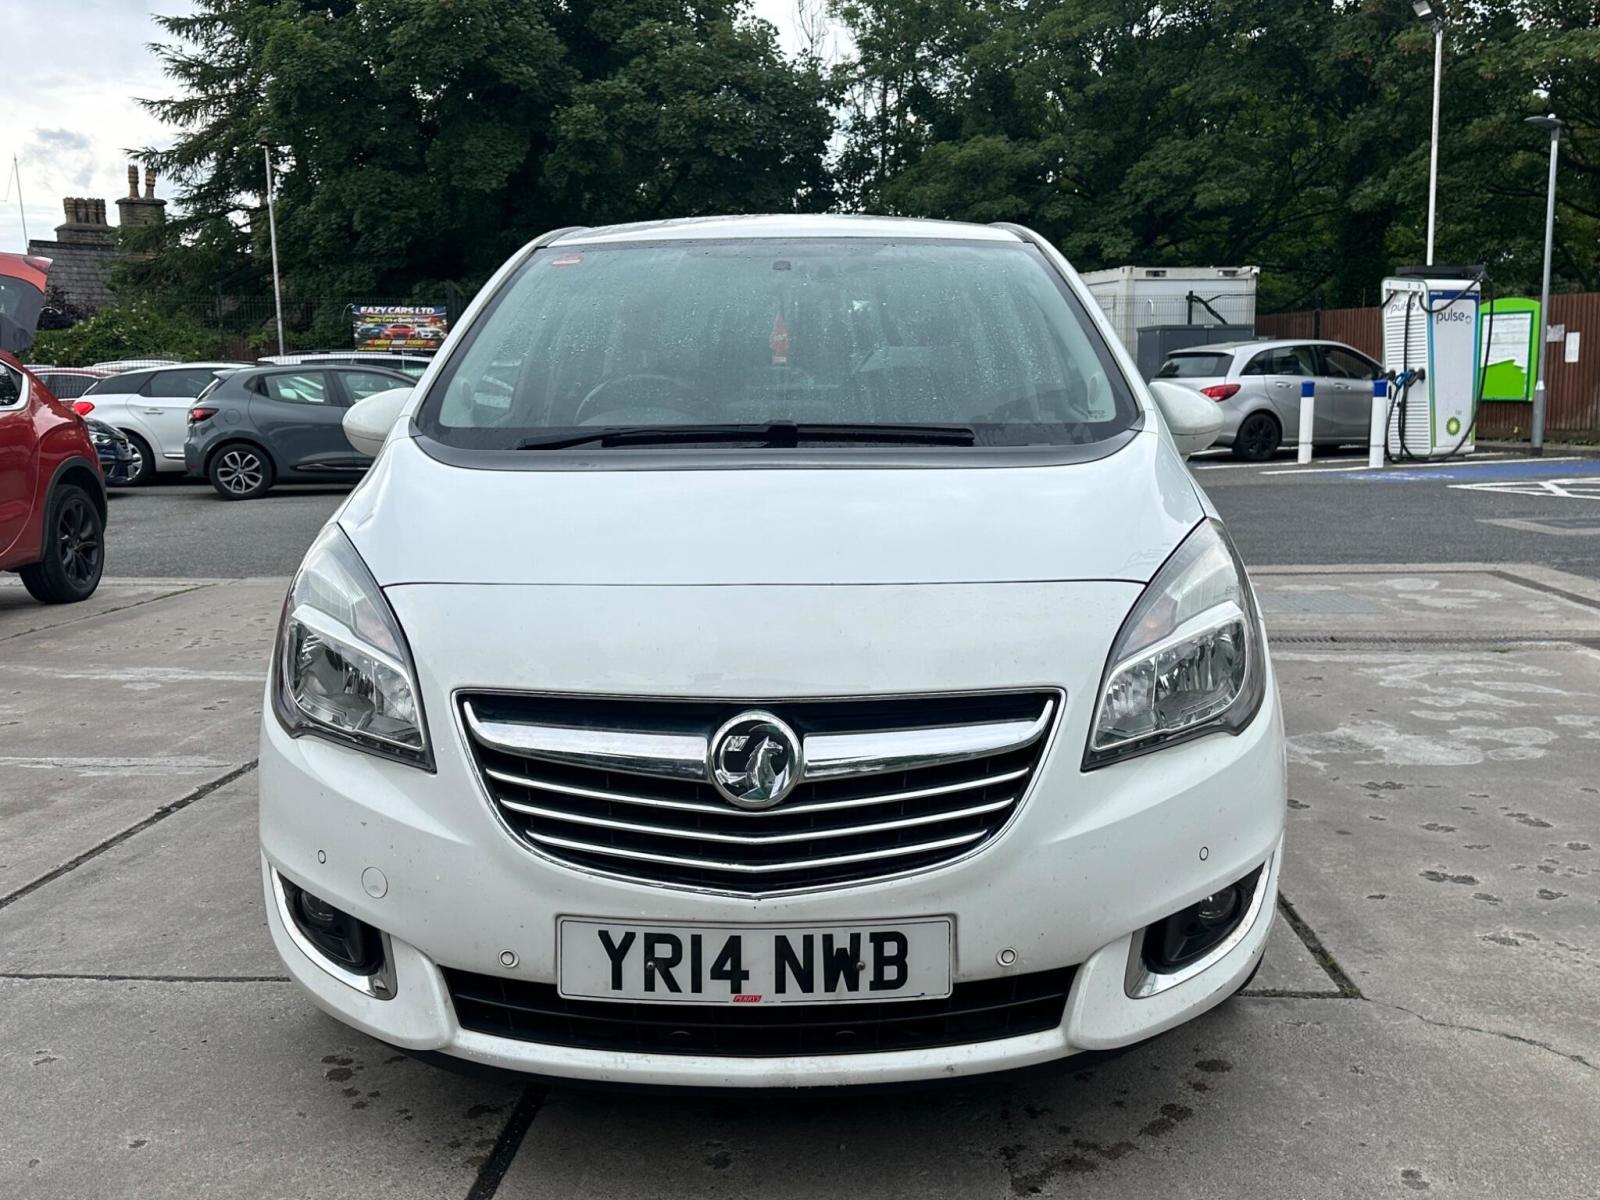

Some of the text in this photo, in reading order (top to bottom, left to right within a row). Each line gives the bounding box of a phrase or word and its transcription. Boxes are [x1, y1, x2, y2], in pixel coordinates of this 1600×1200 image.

[360, 306, 435, 314] EAZY CARS LTD
[1436, 307, 1465, 325] pulse
[597, 930, 909, 994] YR14 NWB
